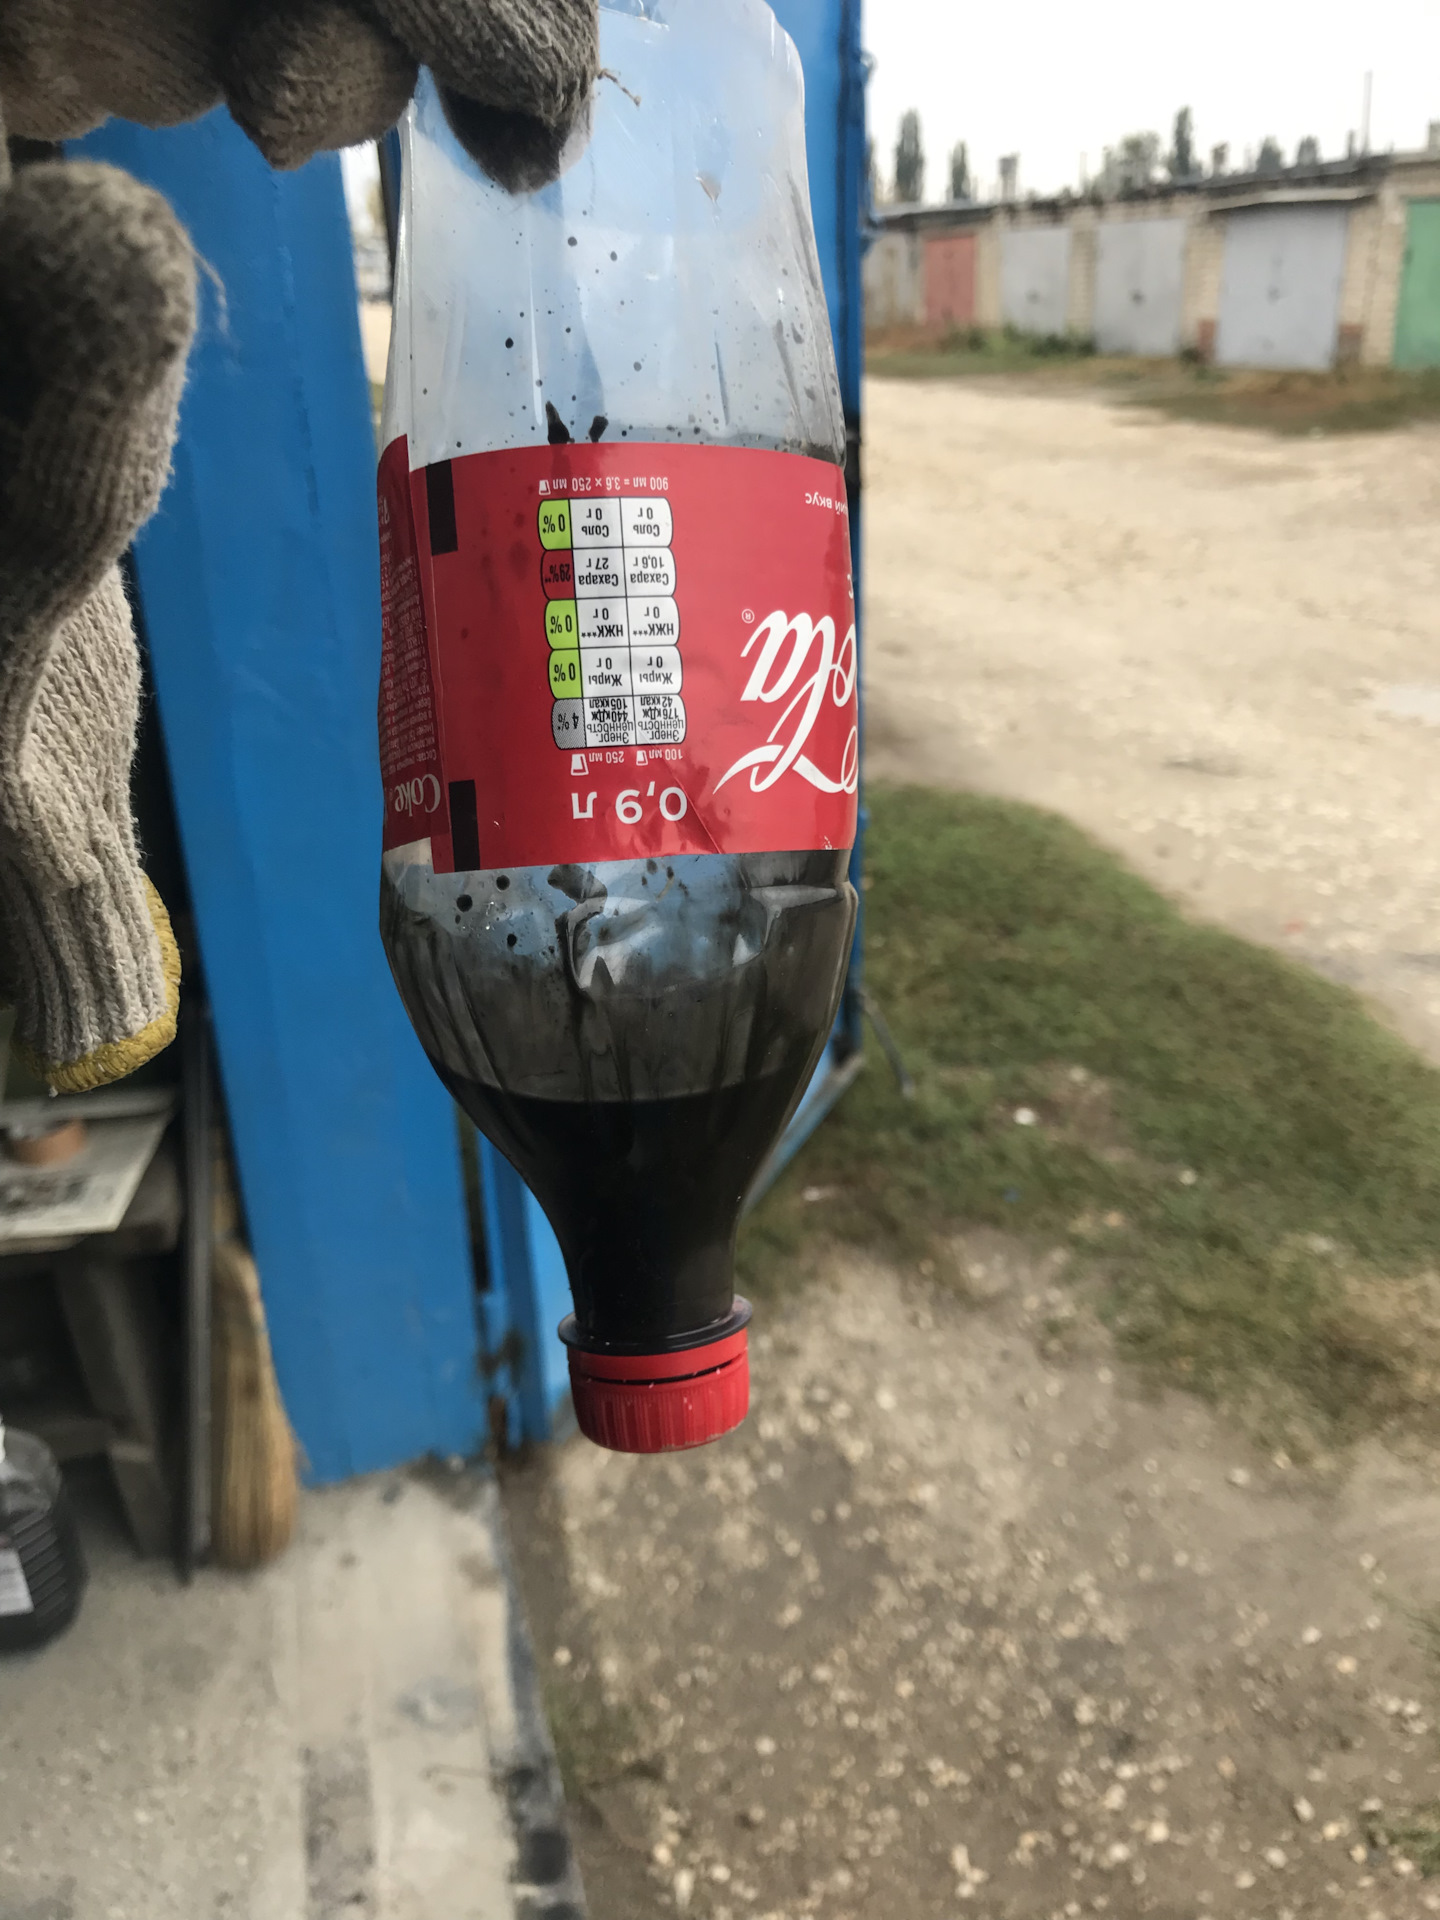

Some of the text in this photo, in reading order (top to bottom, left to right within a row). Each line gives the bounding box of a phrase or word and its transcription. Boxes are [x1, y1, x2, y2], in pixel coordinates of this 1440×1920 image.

[553, 479, 567, 490] мл
[572, 478, 591, 491] 250
[606, 477, 621, 490] 3.6
[633, 477, 646, 487] мл
[650, 477, 668, 490] 900
[805, 492, 832, 509] вкус
[586, 508, 602, 520] 0 г
[638, 507, 653, 519] 0 г
[581, 525, 609, 538] Соль
[633, 524, 660, 537] Соль
[586, 558, 609, 569] 27 г
[633, 555, 664, 568] 10,6 г
[578, 572, 619, 586] Сахара
[630, 571, 669, 585] Сахара
[593, 608, 609, 620] 0 г
[644, 607, 660, 618] 0 г
[596, 658, 612, 669] 0 г
[647, 656, 663, 668] 0 г
[588, 672, 622, 686] Жиры
[639, 671, 673, 684] Жиры
[572, 713, 579, 729] 4
[586, 721, 633, 734] ценность
[638, 719, 684, 730] ценность
[596, 731, 629, 744] Энерг.
[647, 728, 679, 741] Энерг.
[589, 751, 624, 763] 250 мл
[649, 749, 683, 760] 100 мл
[394, 774, 441, 817] Coke
[615, 781, 687, 824] 0,9
